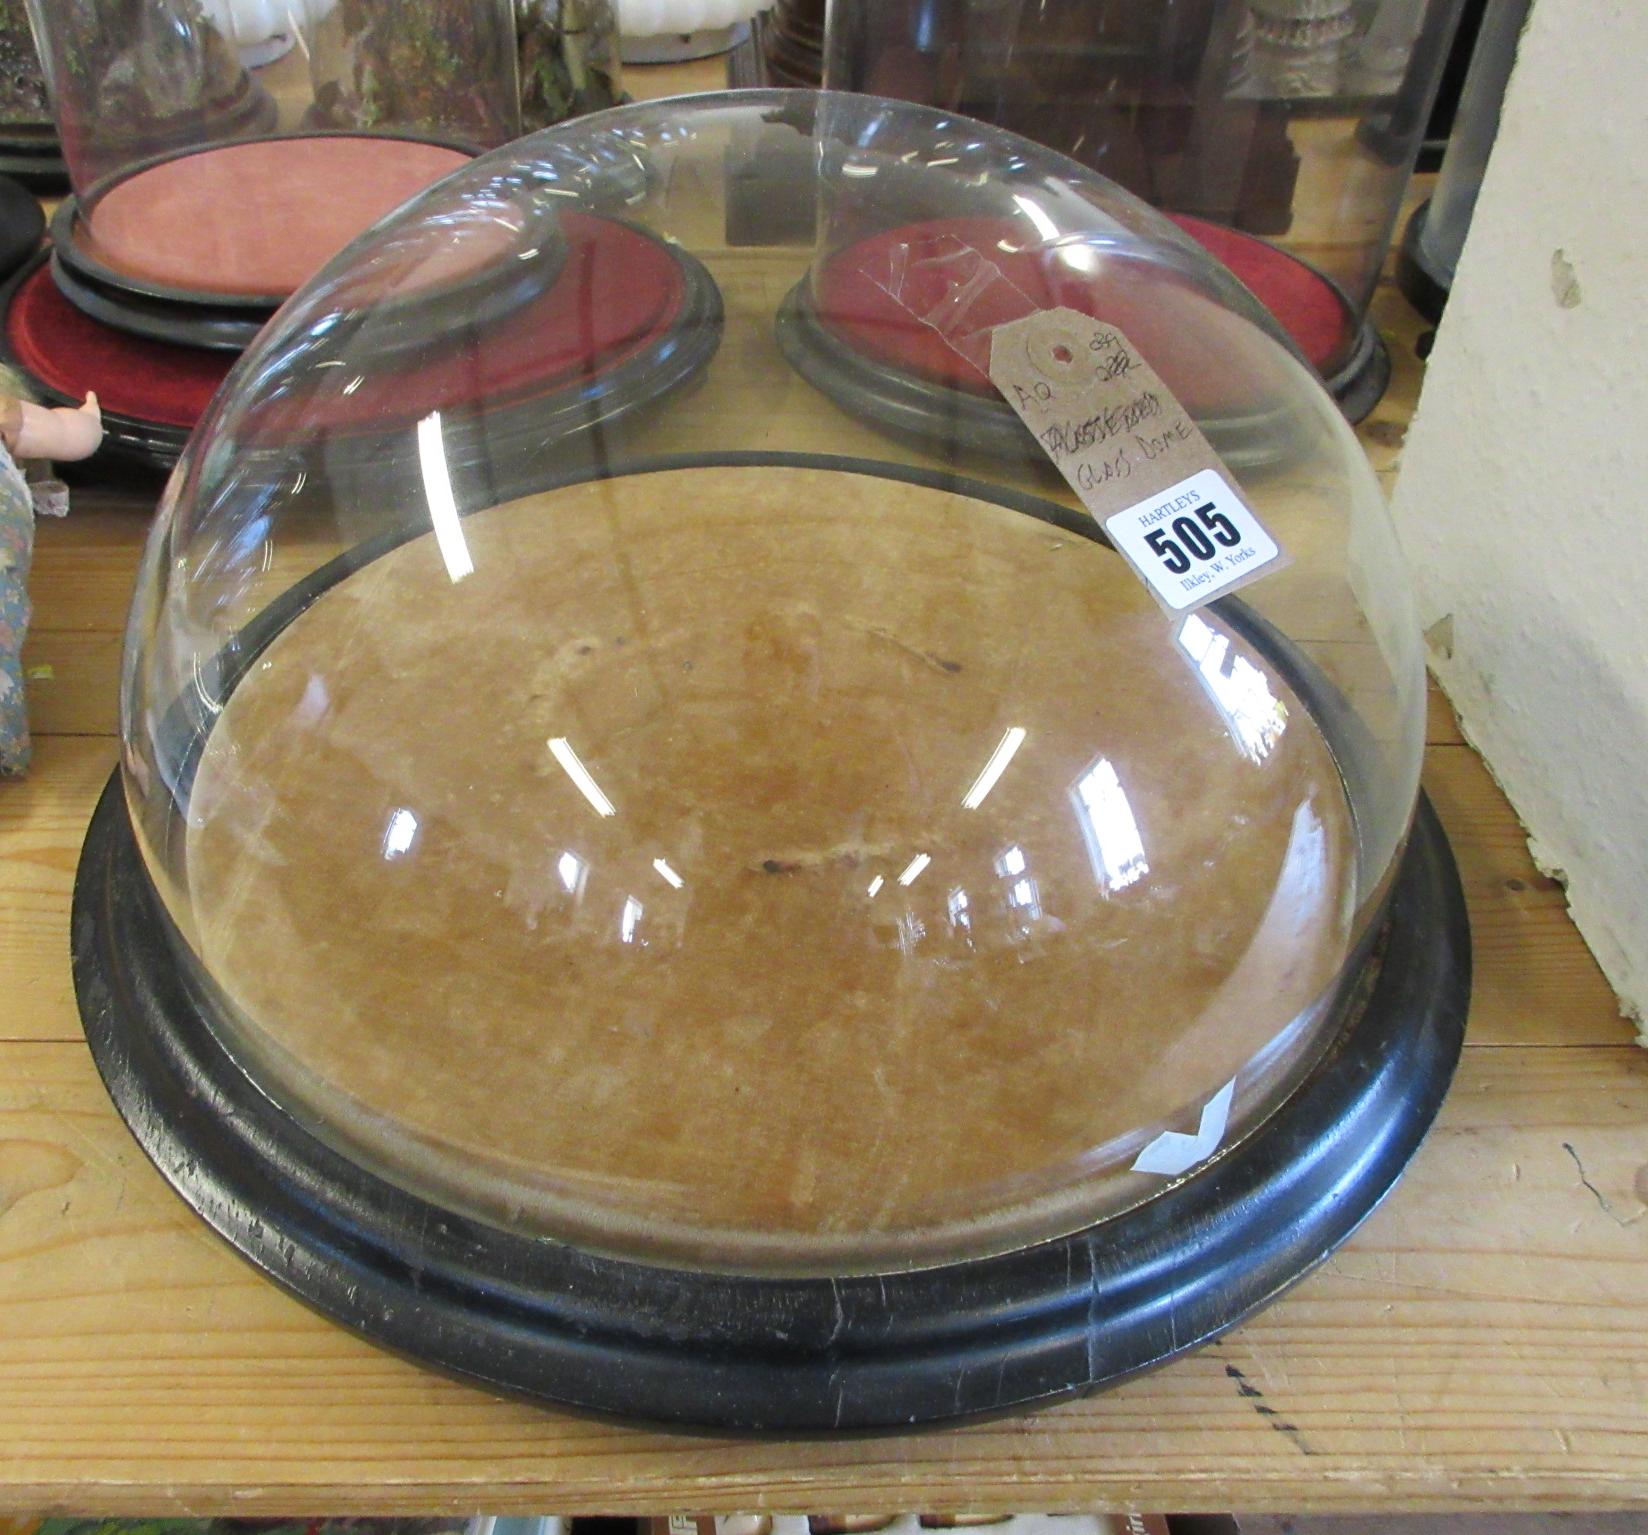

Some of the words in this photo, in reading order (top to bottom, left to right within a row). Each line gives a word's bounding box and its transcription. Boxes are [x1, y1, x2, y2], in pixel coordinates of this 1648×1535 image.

[1138, 490, 1201, 527] HARTLEYS
[1143, 502, 1241, 574] 505
[1180, 569, 1215, 592] Ilkley,
[1210, 561, 1230, 574] W.
[1225, 546, 1256, 566] Yorks
